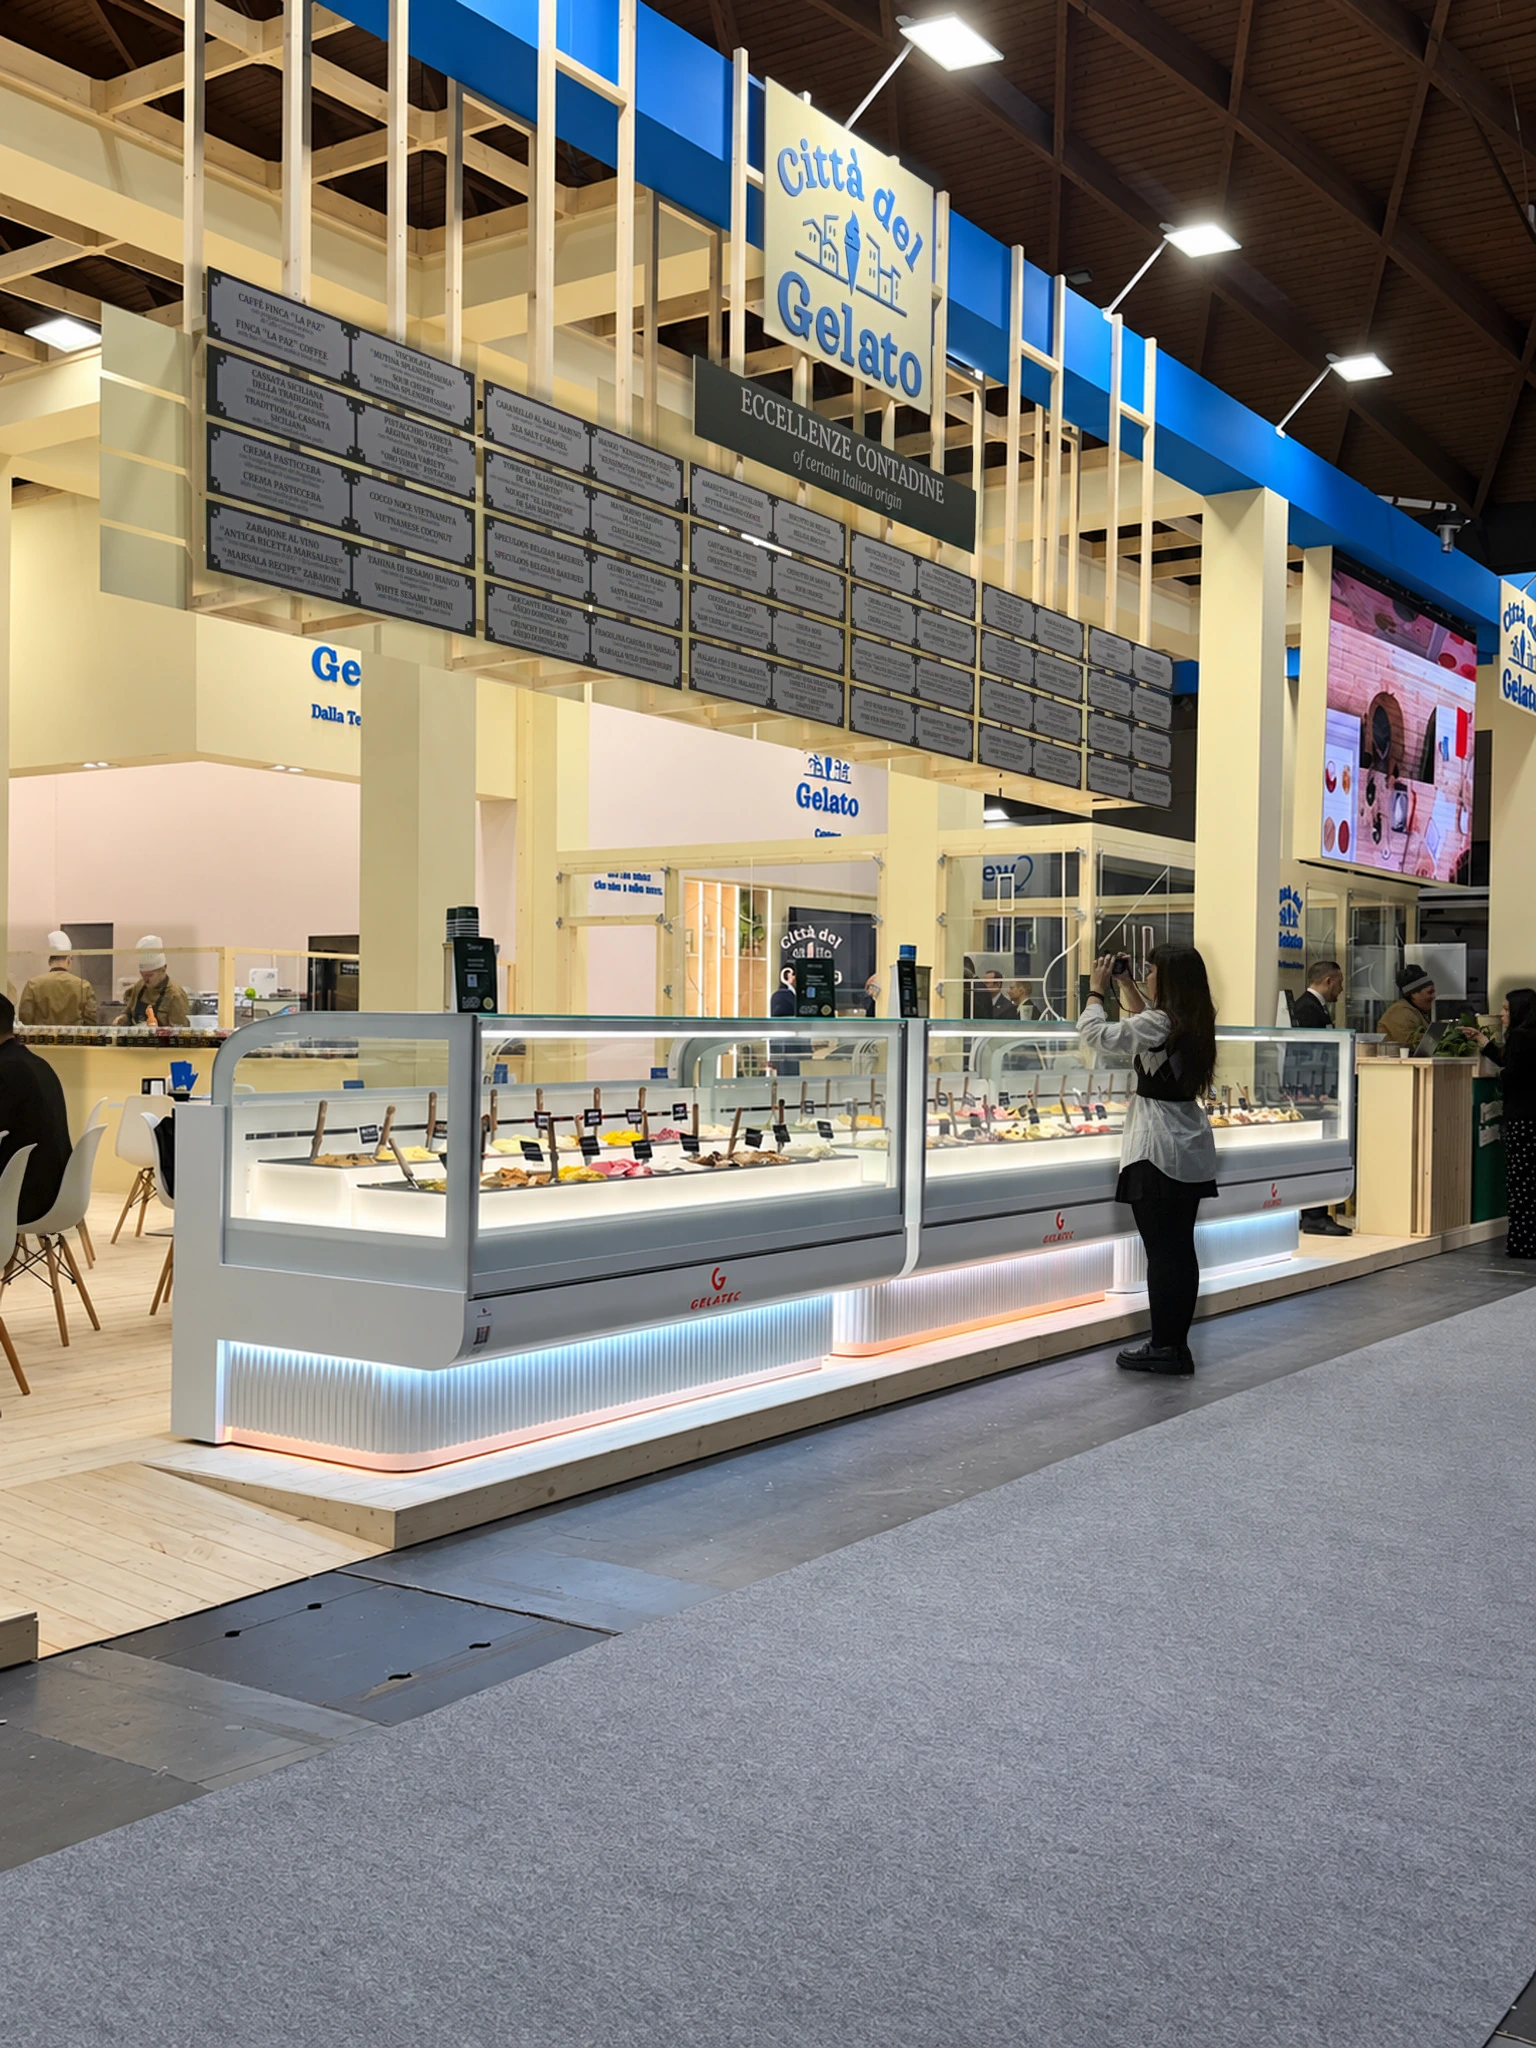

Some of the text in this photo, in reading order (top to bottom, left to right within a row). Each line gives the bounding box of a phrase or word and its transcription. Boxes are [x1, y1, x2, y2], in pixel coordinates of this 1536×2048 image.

[777, 138, 923, 272] Città del
[265, 303, 289, 320] FINCA
[236, 318, 261, 336] FINCA
[299, 342, 328, 361] COFFEE
[777, 271, 922, 398] Gelato
[395, 349, 432, 371] VISCIOLATA
[252, 368, 324, 402] CASSATA SICILIANA
[252, 379, 277, 395] DELLA
[278, 388, 324, 412] TRADIZIONE
[245, 394, 297, 420] TRADITIONAL
[298, 412, 331, 432] CASSATA
[270, 413, 306, 433] SICILIANA
[384, 415, 424, 437] PISTACCHIO
[496, 398, 533, 421] CARAMELLO
[543, 417, 557, 430] SALE
[511, 422, 568, 452] SEA SALT CARAMEL
[741, 387, 945, 505] ECCELLENZE CONTADINE
[243, 443, 272, 461] CREMA
[273, 453, 321, 476] PASTICCERA
[417, 454, 446, 471] VARIETY
[423, 465, 457, 483] PISTACHIO
[243, 471, 272, 488] CREMA
[273, 480, 321, 503] PASTICCERA
[793, 450, 902, 511] of certain Italian origin
[369, 491, 393, 506] COCCO
[393, 499, 413, 512] NOCE
[413, 505, 457, 526] VIETNAMITA
[246, 521, 320, 550] ZABAJONE AL VINO
[374, 512, 420, 533] VIETNAMESE
[421, 526, 453, 543] COCONUT
[257, 536, 292, 554] RICETTA
[494, 531, 529, 550] SPECULOOS
[530, 543, 555, 558] BELGIAN
[303, 568, 342, 588] ZABAJONE
[368, 555, 395, 570] TAHINA
[397, 563, 404, 573] DI
[405, 566, 434, 581] SESAMO
[435, 574, 460, 588] BIANCO
[494, 550, 529, 568] SPECULOOS
[530, 560, 555, 576] BELGIAN
[374, 582, 399, 596] WHITE
[400, 589, 428, 604] SESAME
[429, 597, 453, 611] TAHINI
[1503, 668, 1536, 712] Gelat
[311, 703, 344, 723] Dalla
[796, 782, 859, 817] Gelato
[780, 925, 843, 949] Città del
[690, 1291, 741, 1310] GELATEC
